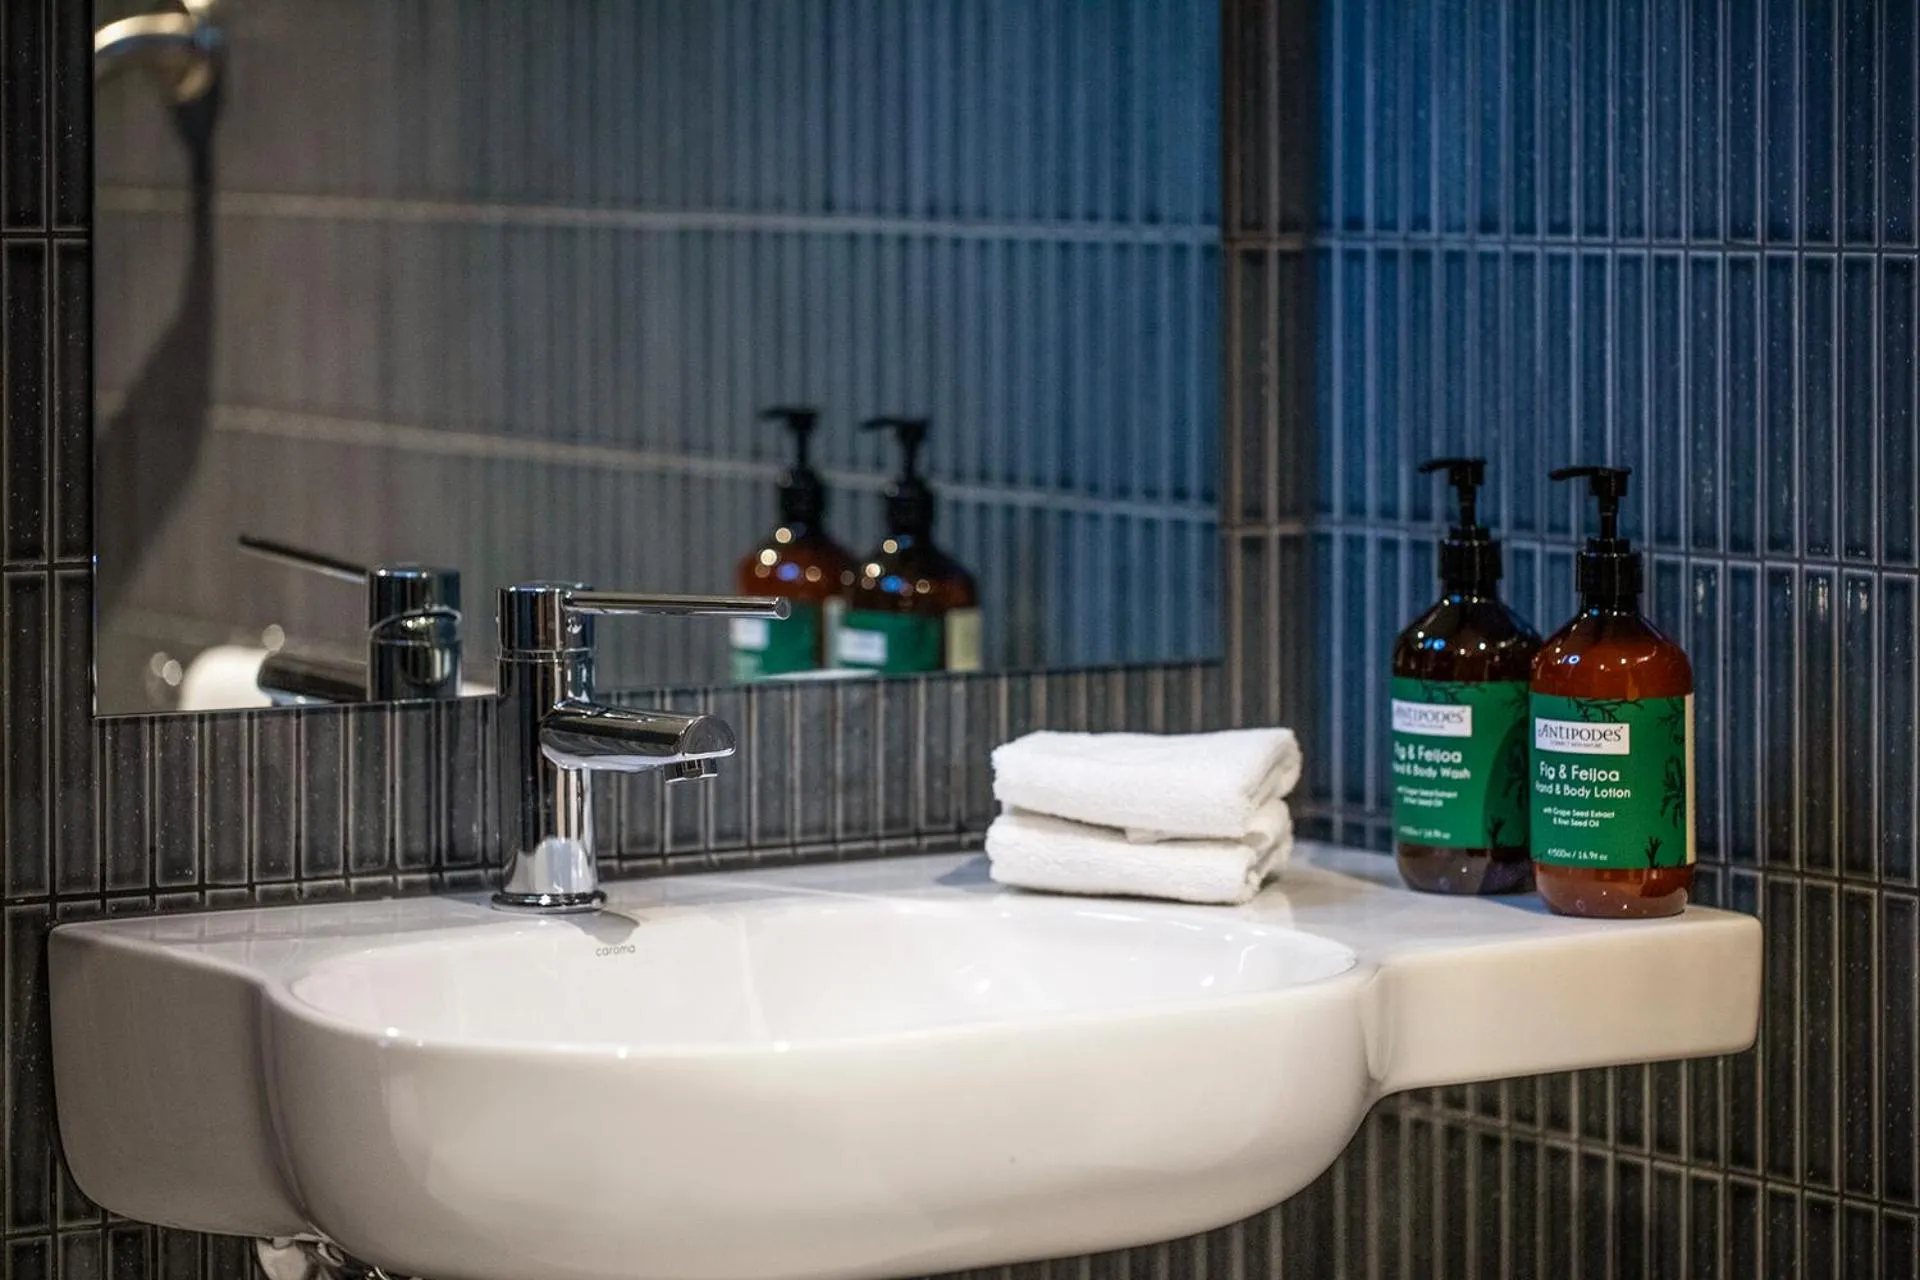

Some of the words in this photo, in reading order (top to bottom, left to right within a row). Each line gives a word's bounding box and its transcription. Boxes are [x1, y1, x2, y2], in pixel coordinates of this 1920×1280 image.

[1418, 745, 1462, 763] Feijoa
[1413, 764, 1437, 780] Body
[1441, 767, 1471, 780] Wash
[1540, 761, 1555, 779] Fig
[1559, 764, 1567, 779] &
[1572, 765, 1619, 782] Feijoa
[1555, 784, 1561, 795] &
[1563, 784, 1591, 799] Body
[1594, 786, 1631, 798] Lotion
[595, 945, 636, 957] caroma
